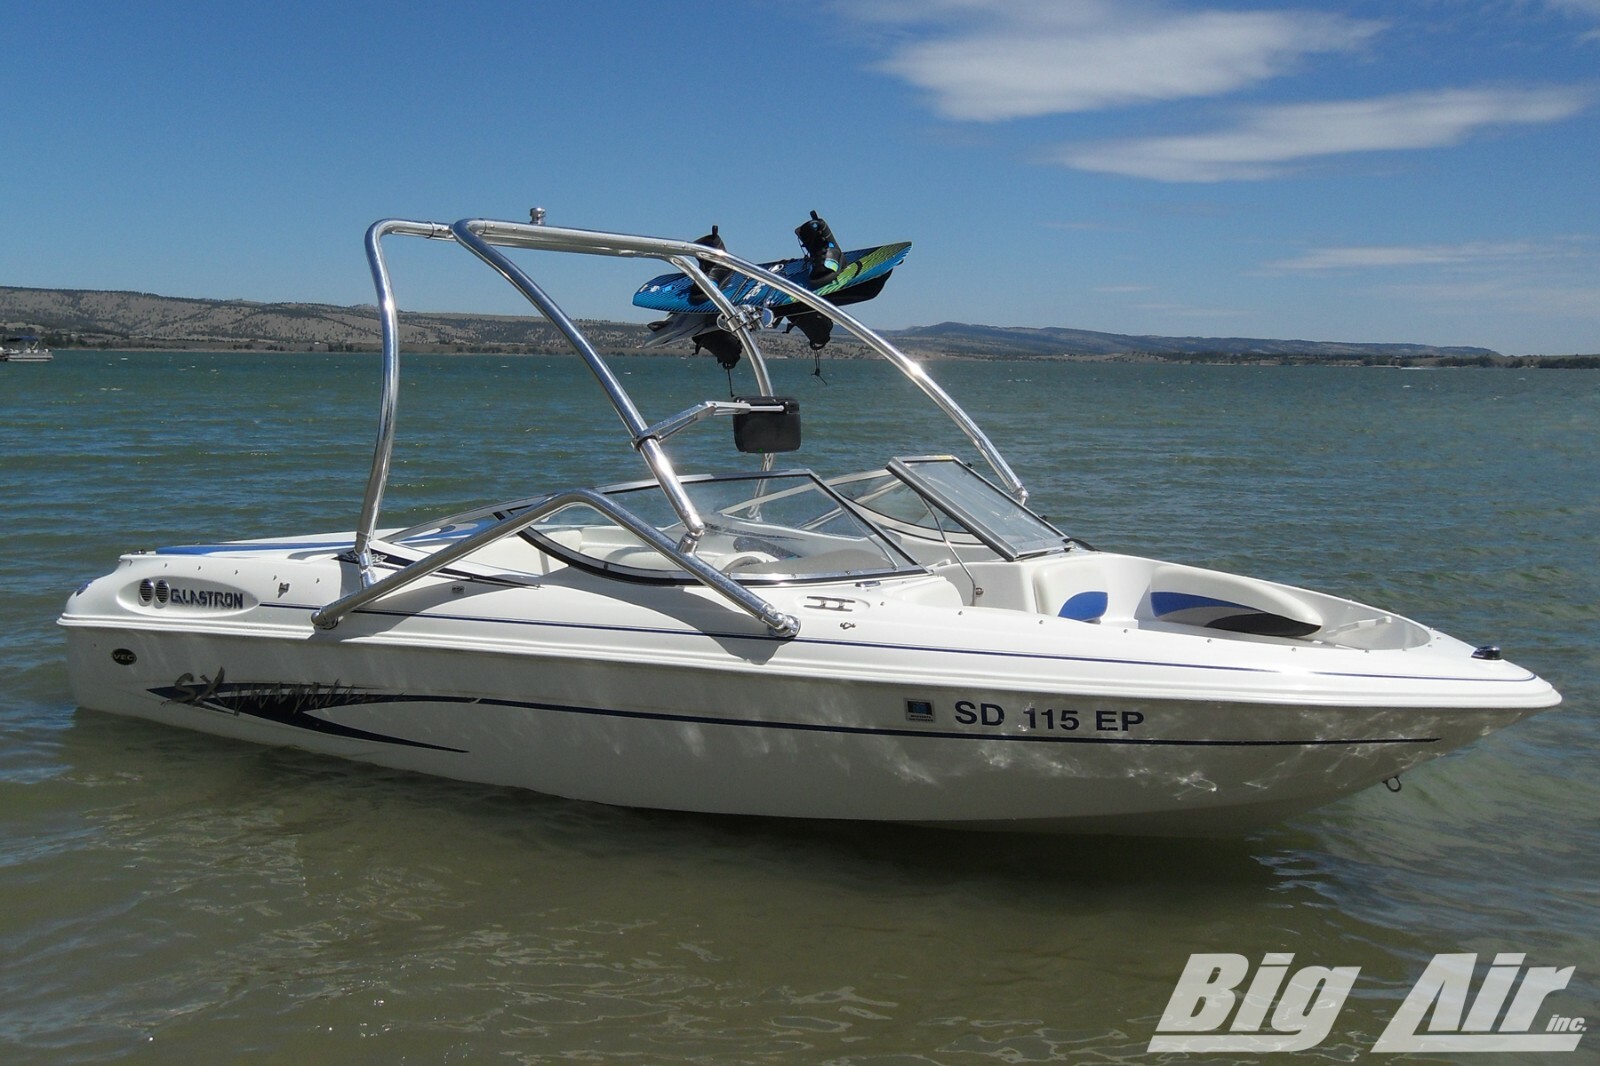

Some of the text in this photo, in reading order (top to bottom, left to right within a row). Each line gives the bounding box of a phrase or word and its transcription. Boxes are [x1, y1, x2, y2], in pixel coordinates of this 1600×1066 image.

[170, 588, 243, 609] GLASTRON
[954, 701, 1145, 731] SD 115 EP
